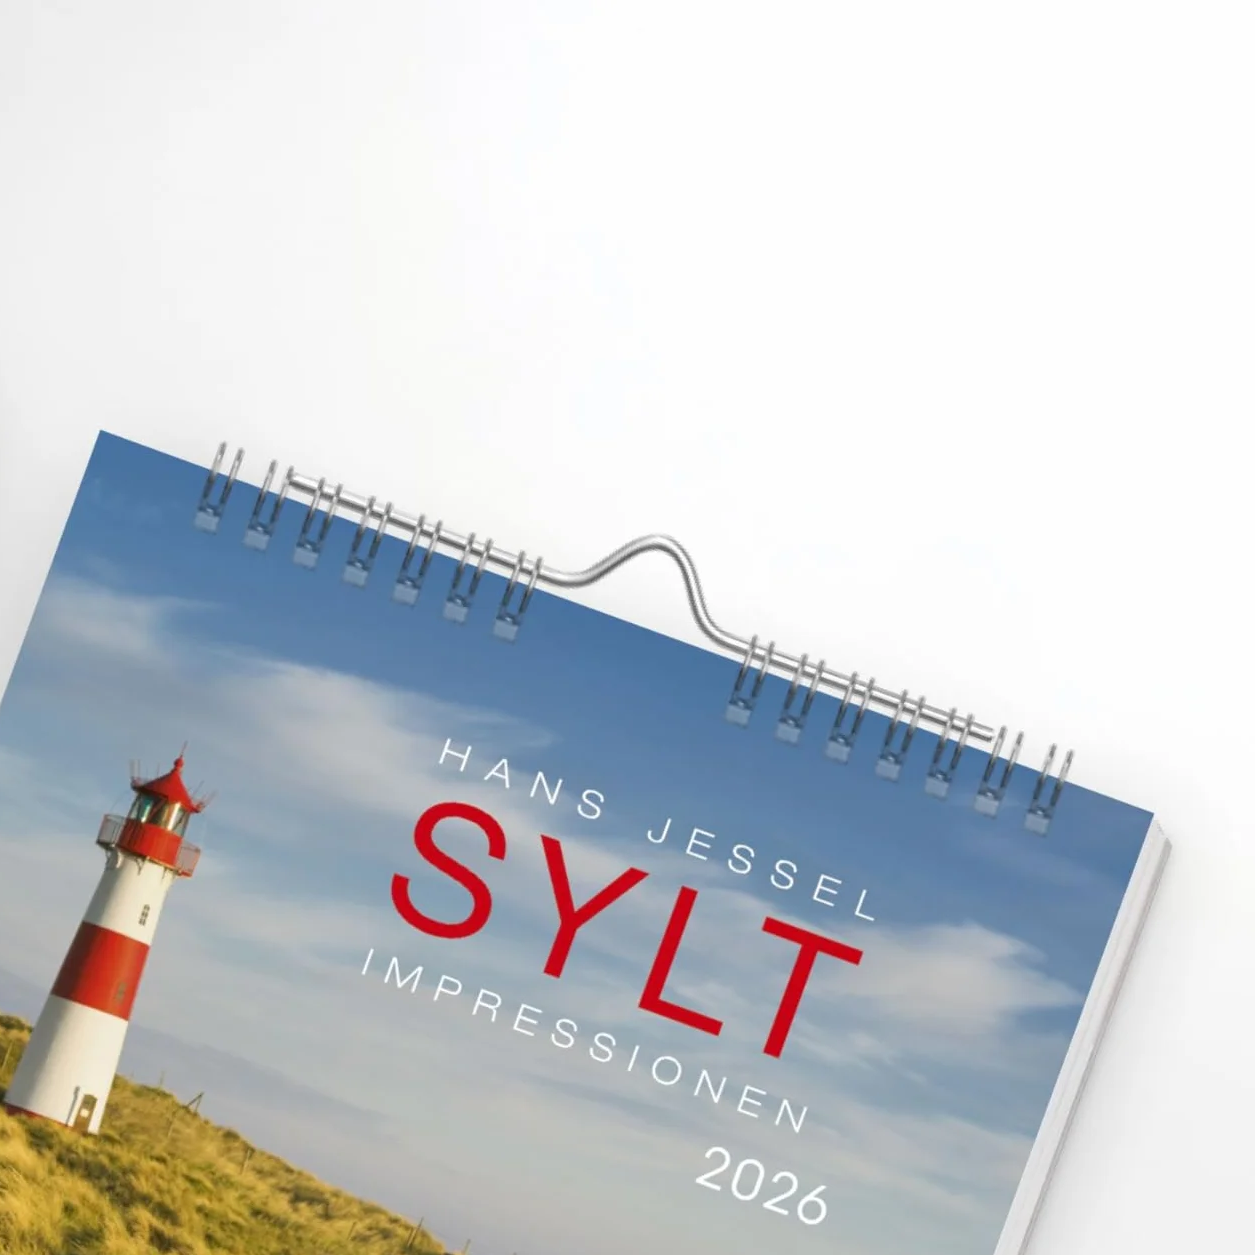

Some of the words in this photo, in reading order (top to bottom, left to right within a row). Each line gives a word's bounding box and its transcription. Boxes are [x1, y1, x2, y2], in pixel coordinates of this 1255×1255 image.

[438, 737, 605, 821] HANS
[646, 818, 876, 922] JESSEL
[391, 801, 864, 1060] SYLT
[360, 947, 808, 1134] IMPRESSIONEN
[694, 1145, 828, 1226] 2026
